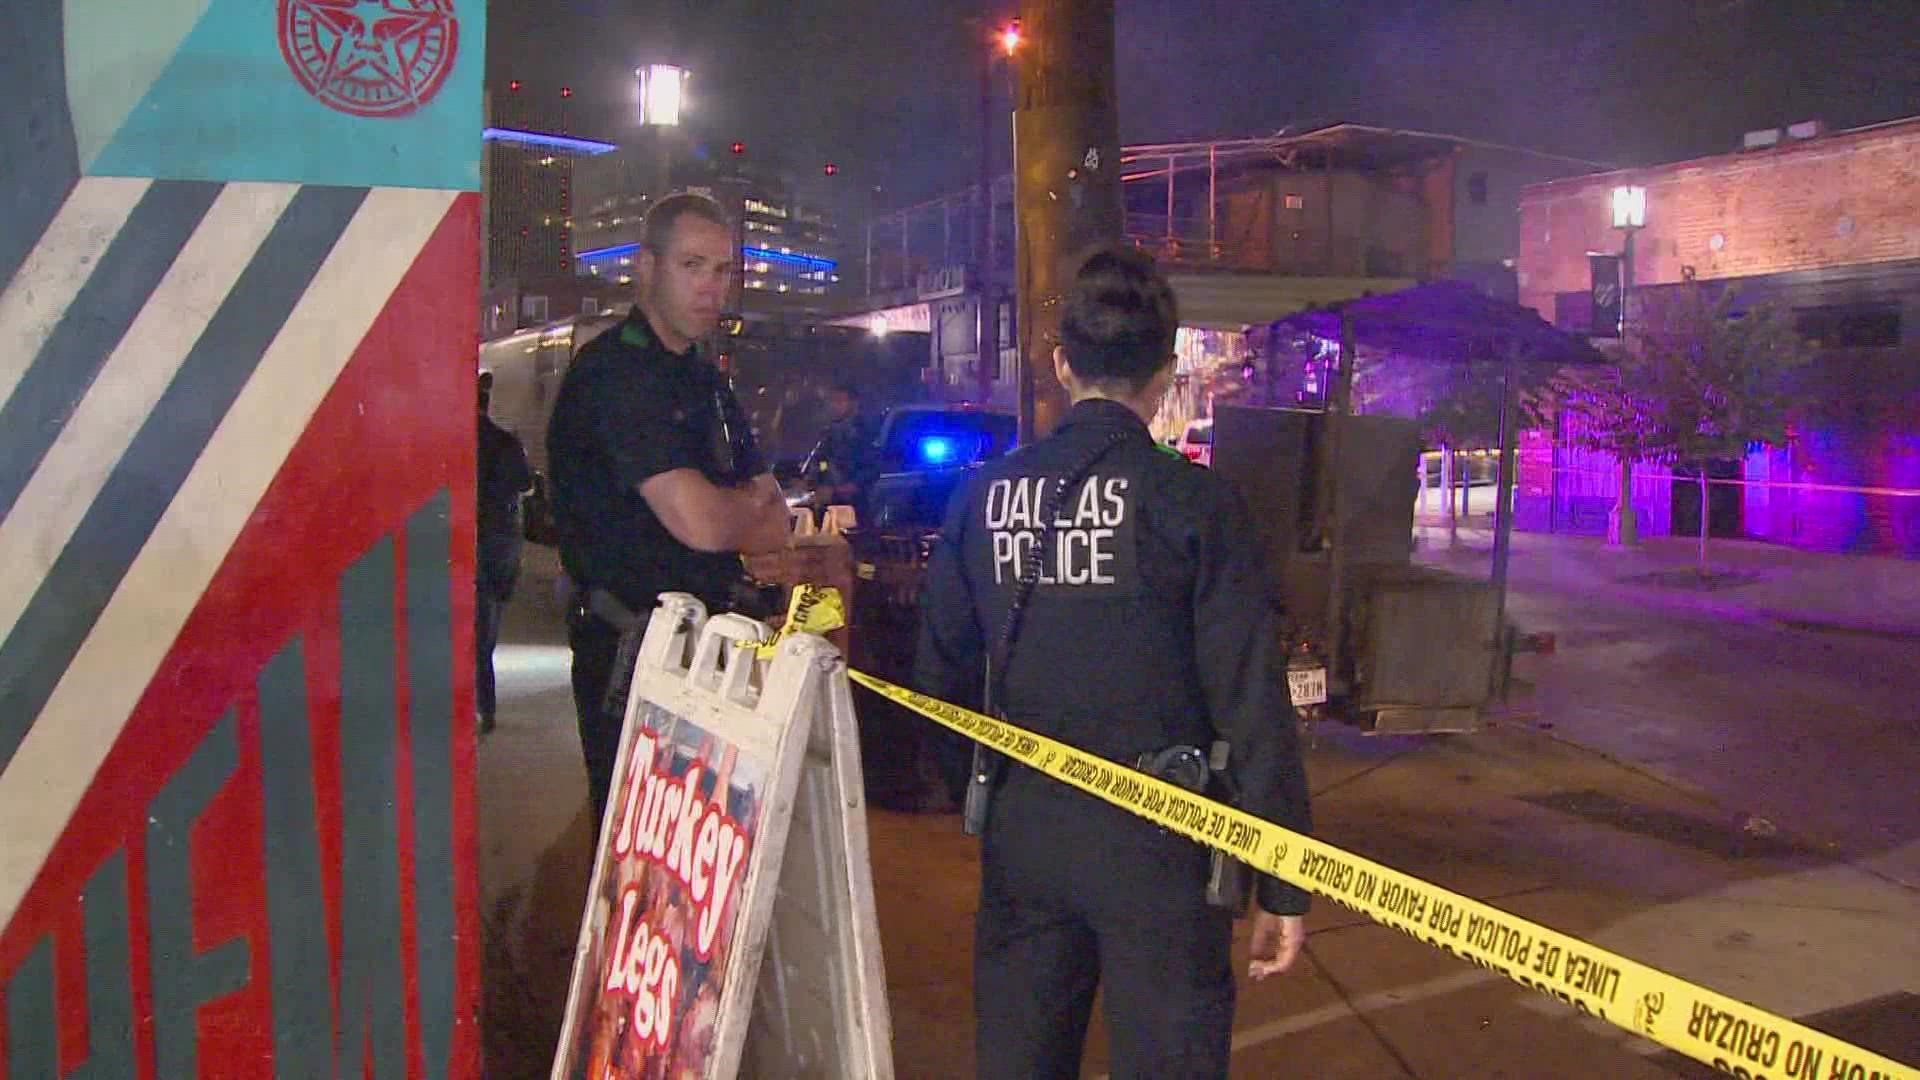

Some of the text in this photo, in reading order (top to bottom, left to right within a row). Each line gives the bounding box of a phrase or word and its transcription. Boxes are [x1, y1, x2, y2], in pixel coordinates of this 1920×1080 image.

[993, 529, 1115, 584] POLICE
[1143, 790, 1168, 815] POR
[1166, 799, 1209, 833] POLICIA
[615, 731, 745, 954] Turkey
[1208, 813, 1226, 838] DE
[1226, 816, 1261, 854] LINEA
[1299, 848, 1354, 889] CRUZAR
[1355, 870, 1378, 898] NO
[1377, 878, 1433, 923] FAVOR
[1430, 896, 1464, 933] POR
[1465, 911, 1534, 965] POLICIA
[607, 888, 678, 1047] Legs
[1534, 941, 1563, 976] DE
[1565, 953, 1622, 1003] LINEA
[1687, 1000, 1780, 1068] CRUZAR
[1785, 1040, 1822, 1080] NO
